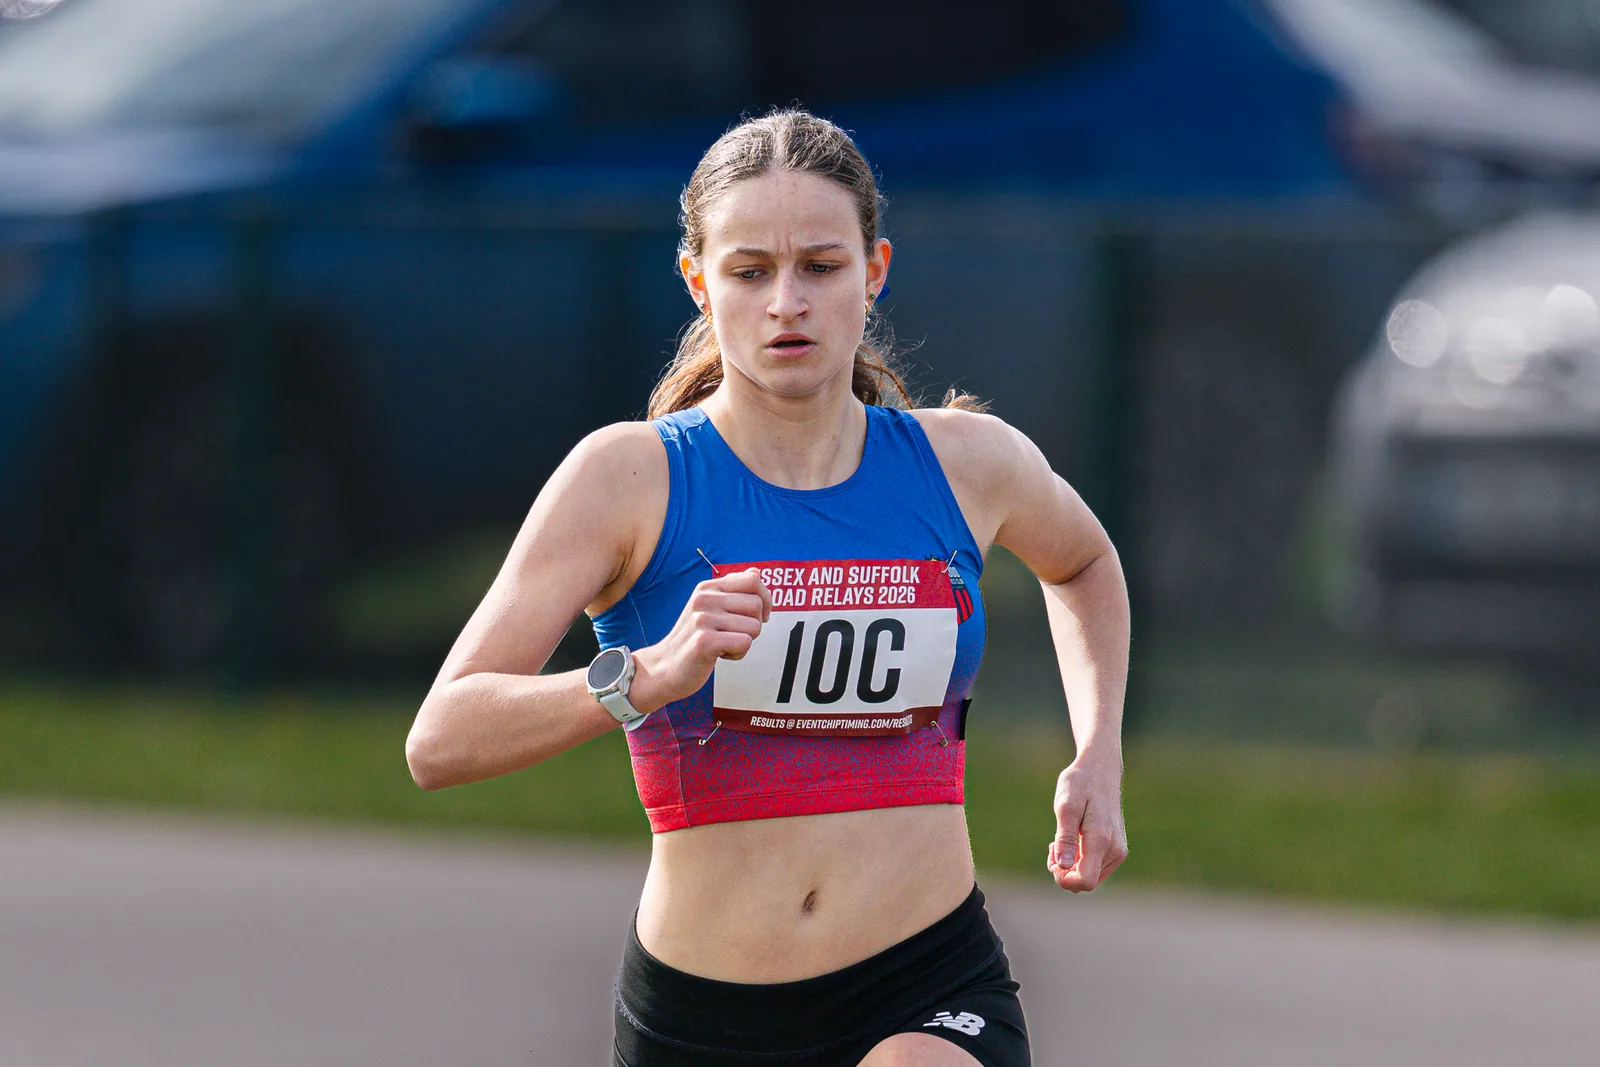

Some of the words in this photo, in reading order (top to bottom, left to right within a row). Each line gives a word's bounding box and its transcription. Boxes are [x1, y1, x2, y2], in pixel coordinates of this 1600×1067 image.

[759, 567, 805, 586] SSEX
[807, 566, 844, 586] AND
[847, 565, 921, 585] SUFFOLK
[768, 588, 807, 607] OAD
[811, 586, 875, 606] RELAYS
[877, 585, 916, 604] 2026
[775, 617, 906, 705] 10C
[750, 716, 786, 729] RESULTS
[786, 719, 796, 729] @
